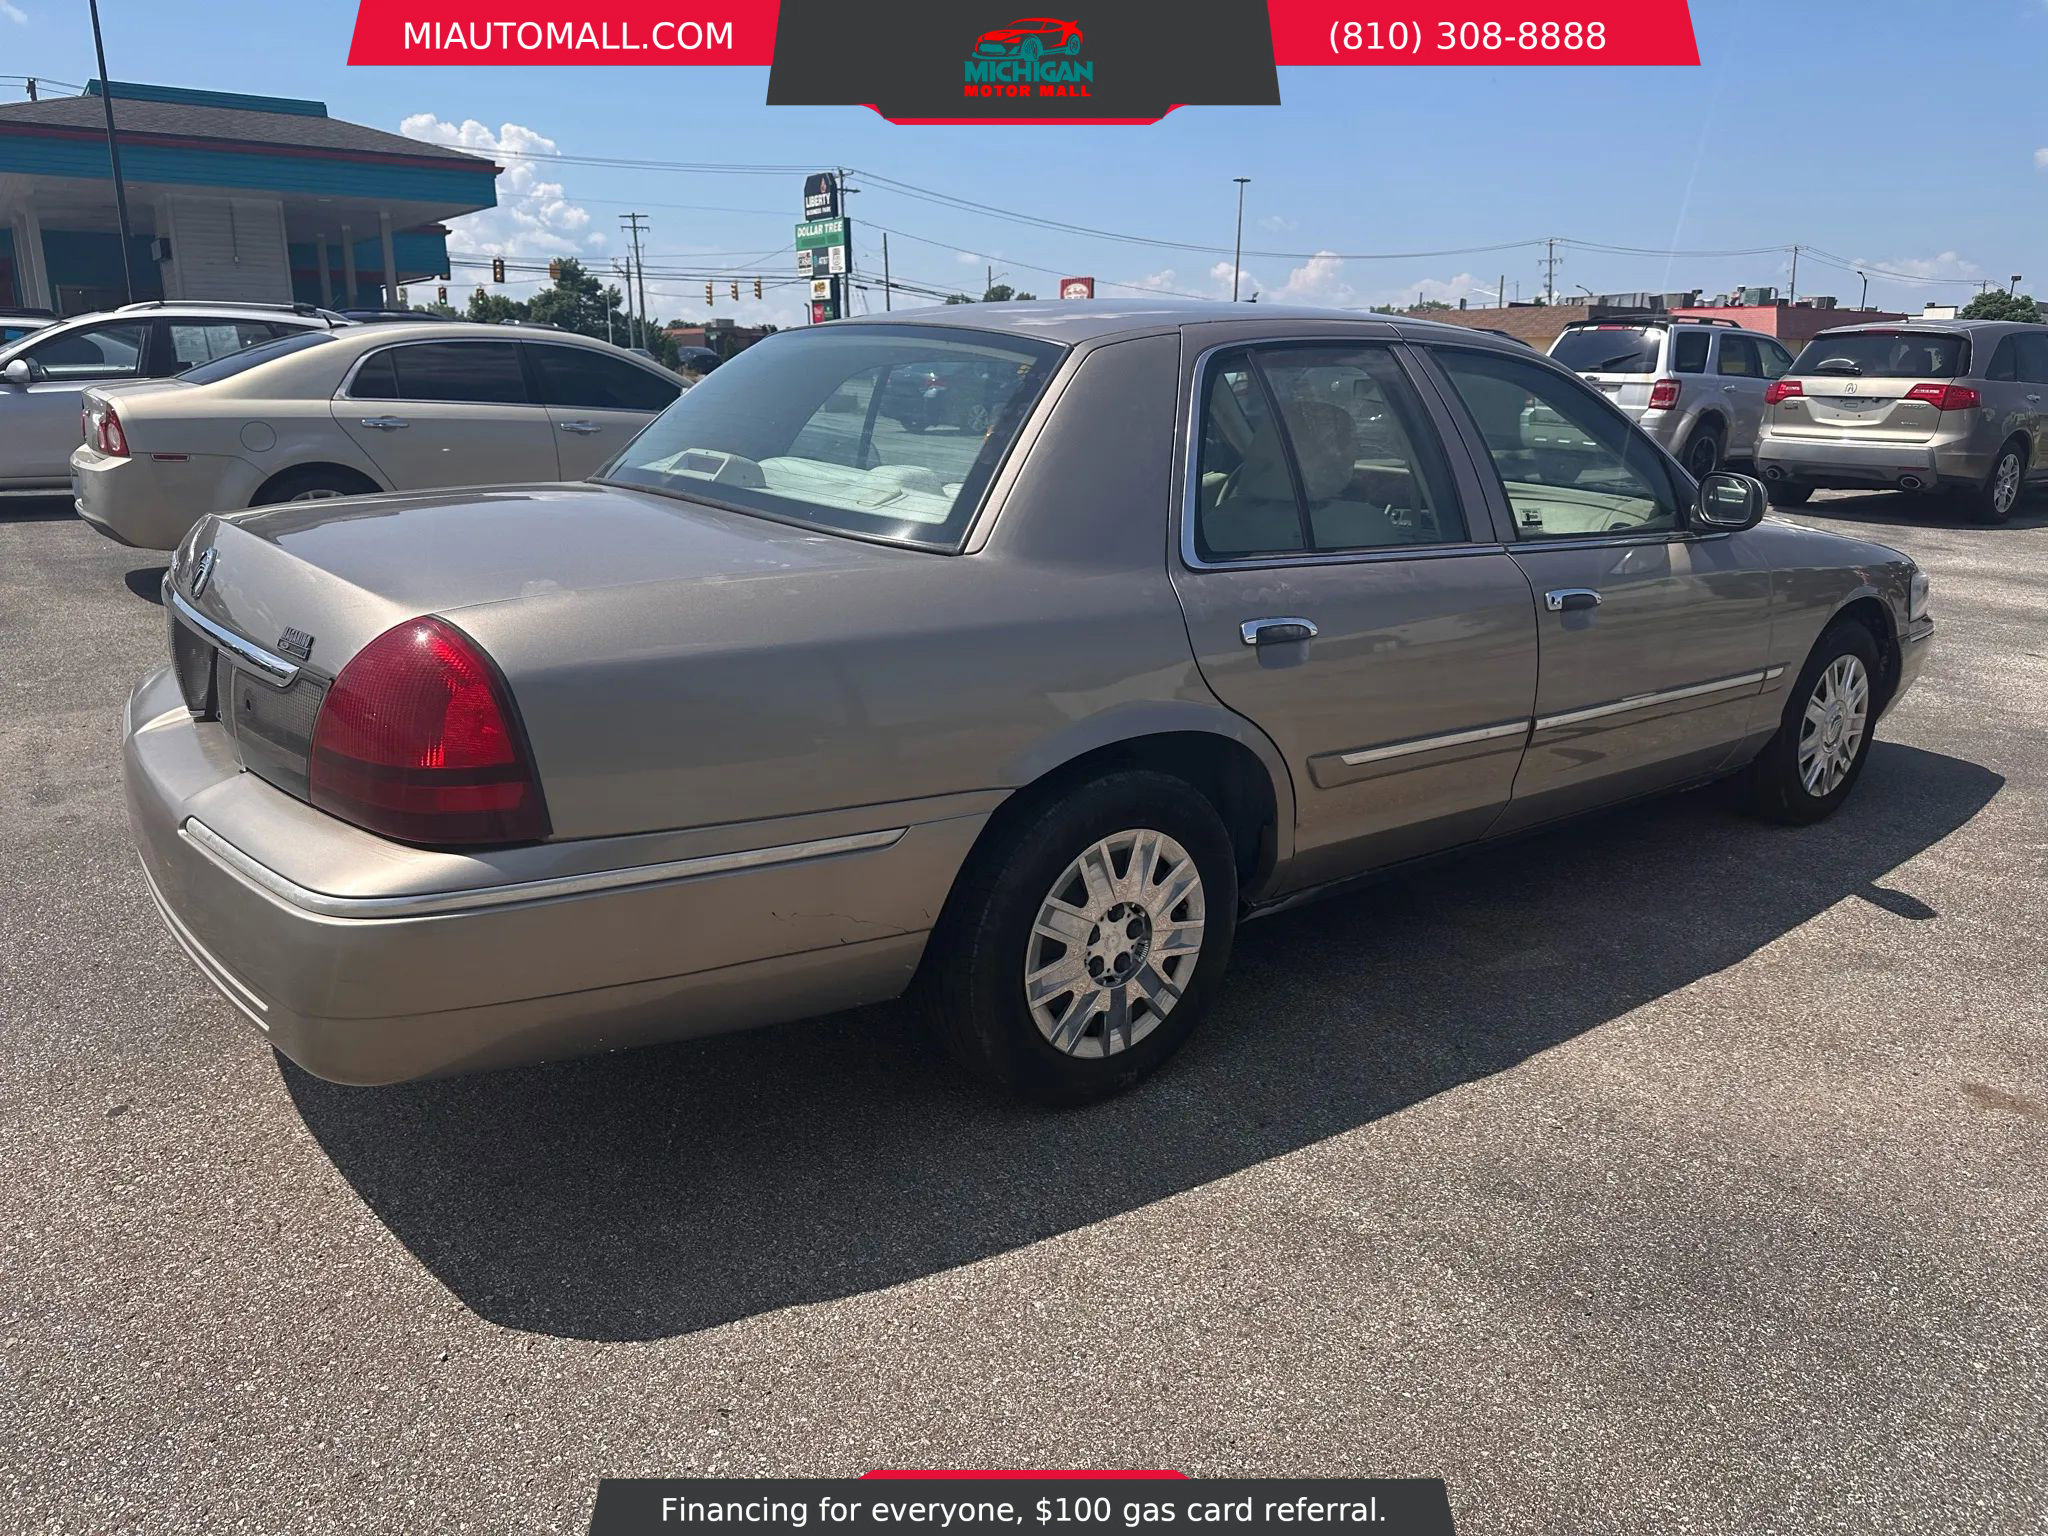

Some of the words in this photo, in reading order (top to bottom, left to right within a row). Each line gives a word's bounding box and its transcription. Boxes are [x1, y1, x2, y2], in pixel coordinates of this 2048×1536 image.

[805, 192, 831, 209] LIBERTY
[797, 223, 824, 238] DOLLAR
[824, 220, 843, 233] TREE
